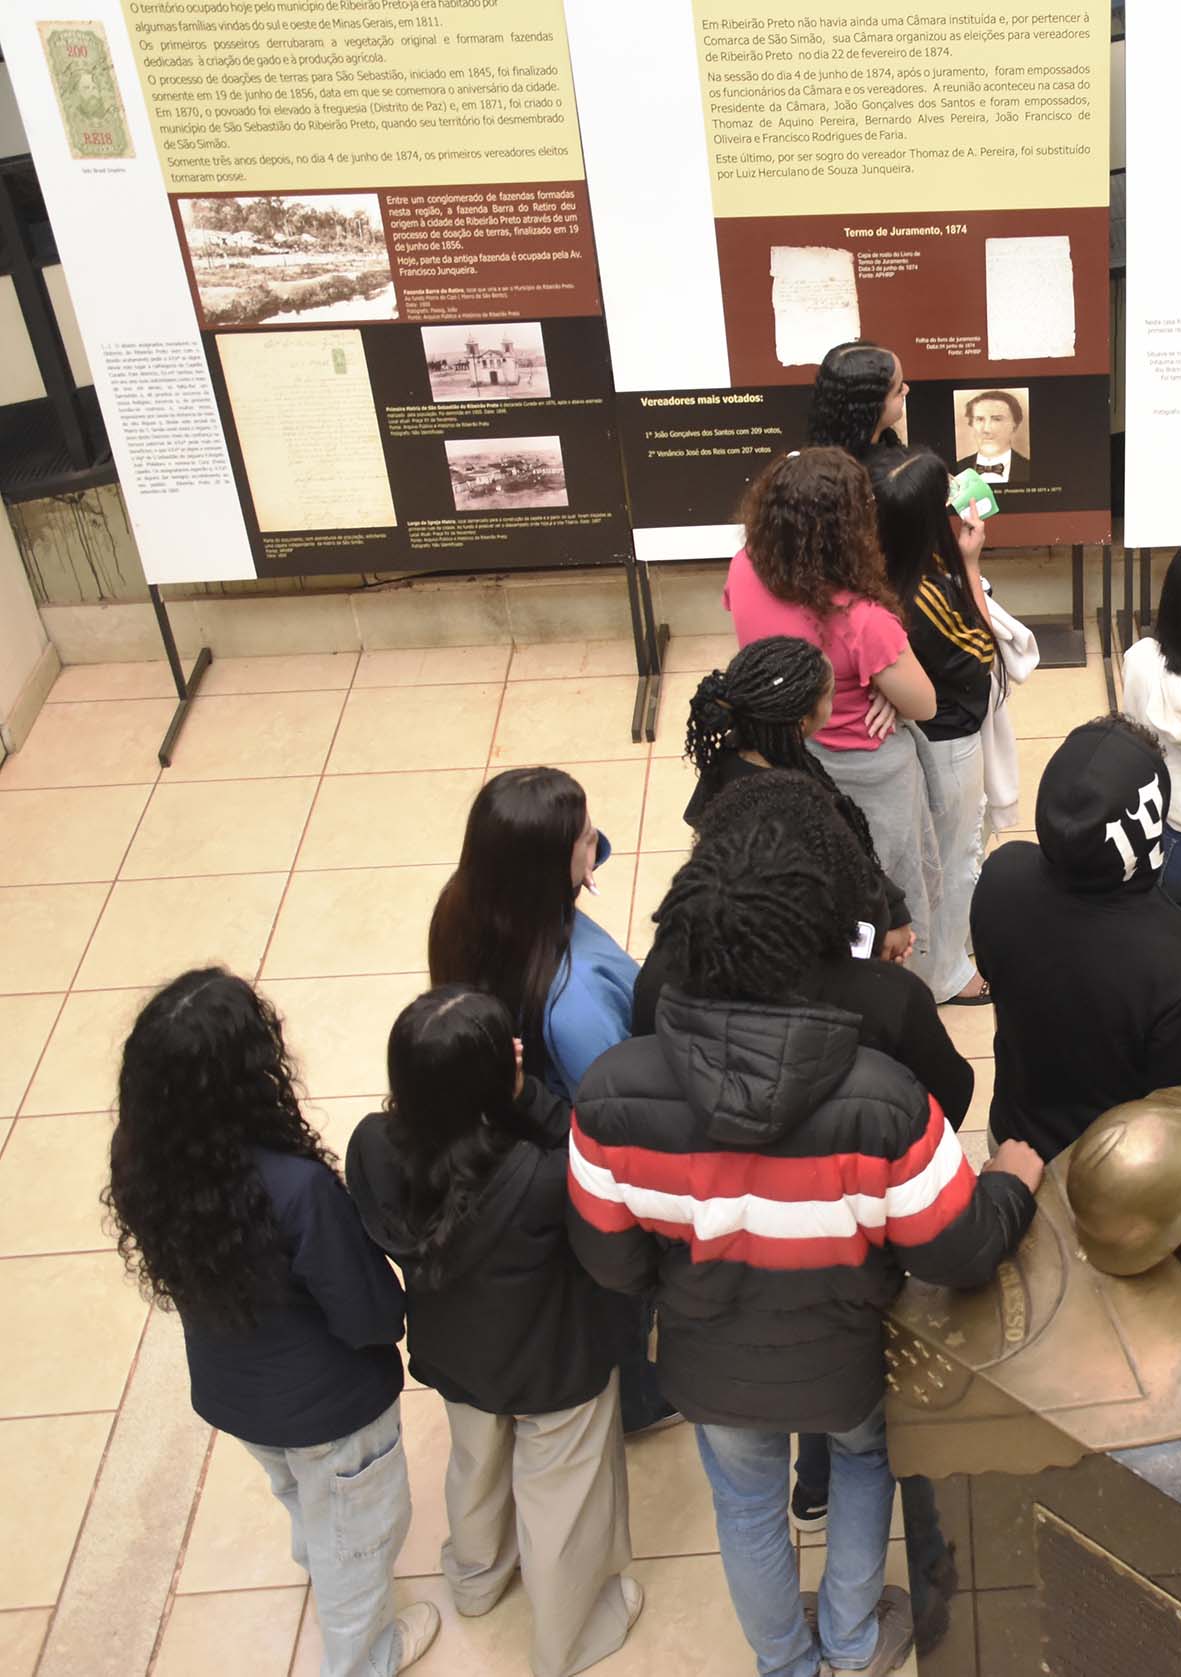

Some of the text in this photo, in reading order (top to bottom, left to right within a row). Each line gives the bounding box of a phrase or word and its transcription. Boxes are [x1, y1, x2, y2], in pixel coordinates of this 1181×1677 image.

[702, 19, 719, 30] Em
[721, 18, 764, 30] Ribeirão
[767, 18, 795, 29] Preto
[797, 18, 817, 28] não
[819, 17, 847, 28] havia
[850, 16, 878, 28] ainda
[881, 18, 904, 27] uma
[906, 15, 946, 27] Câmara
[998, 17, 1008, 28] e,
[1011, 16, 1029, 27] por
[1031, 13, 1080, 27] pertencer
[1083, 13, 1089, 24] à
[138, 31, 553, 51] Os primeiros posseiros derrubaram a vegetação original e formaram fazendas
[705, 46, 952, 62] de Ribeirão Preto no dia 22 de fevereiro de 1874.
[713, 129, 906, 145] Oliveira e Francisco Rodrigues de Faria.
[167, 145, 568, 168] Somente três anos depois, no dia 4 de junho de 1874, os primeiros vereadores eleitos
[216, 173, 246, 184] posse.
[717, 163, 914, 181] por Luiz Herculano de Souza Junqueira.
[386, 190, 574, 206] Entre um conglomerado de fazendas formadas
[844, 225, 967, 238] Termo de Juramento, 1874
[397, 255, 418, 267] Hoje,
[420, 254, 440, 266] parte
[442, 254, 452, 264] da
[453, 253, 478, 265] antiga
[478, 252, 510, 262] fazenda
[517, 250, 551, 263] ocupada
[552, 250, 569, 262] pela
[570, 250, 582, 260] Av.
[399, 265, 477, 278] Francisco Junqueira.
[640, 393, 763, 407] Vereadores mais votados:
